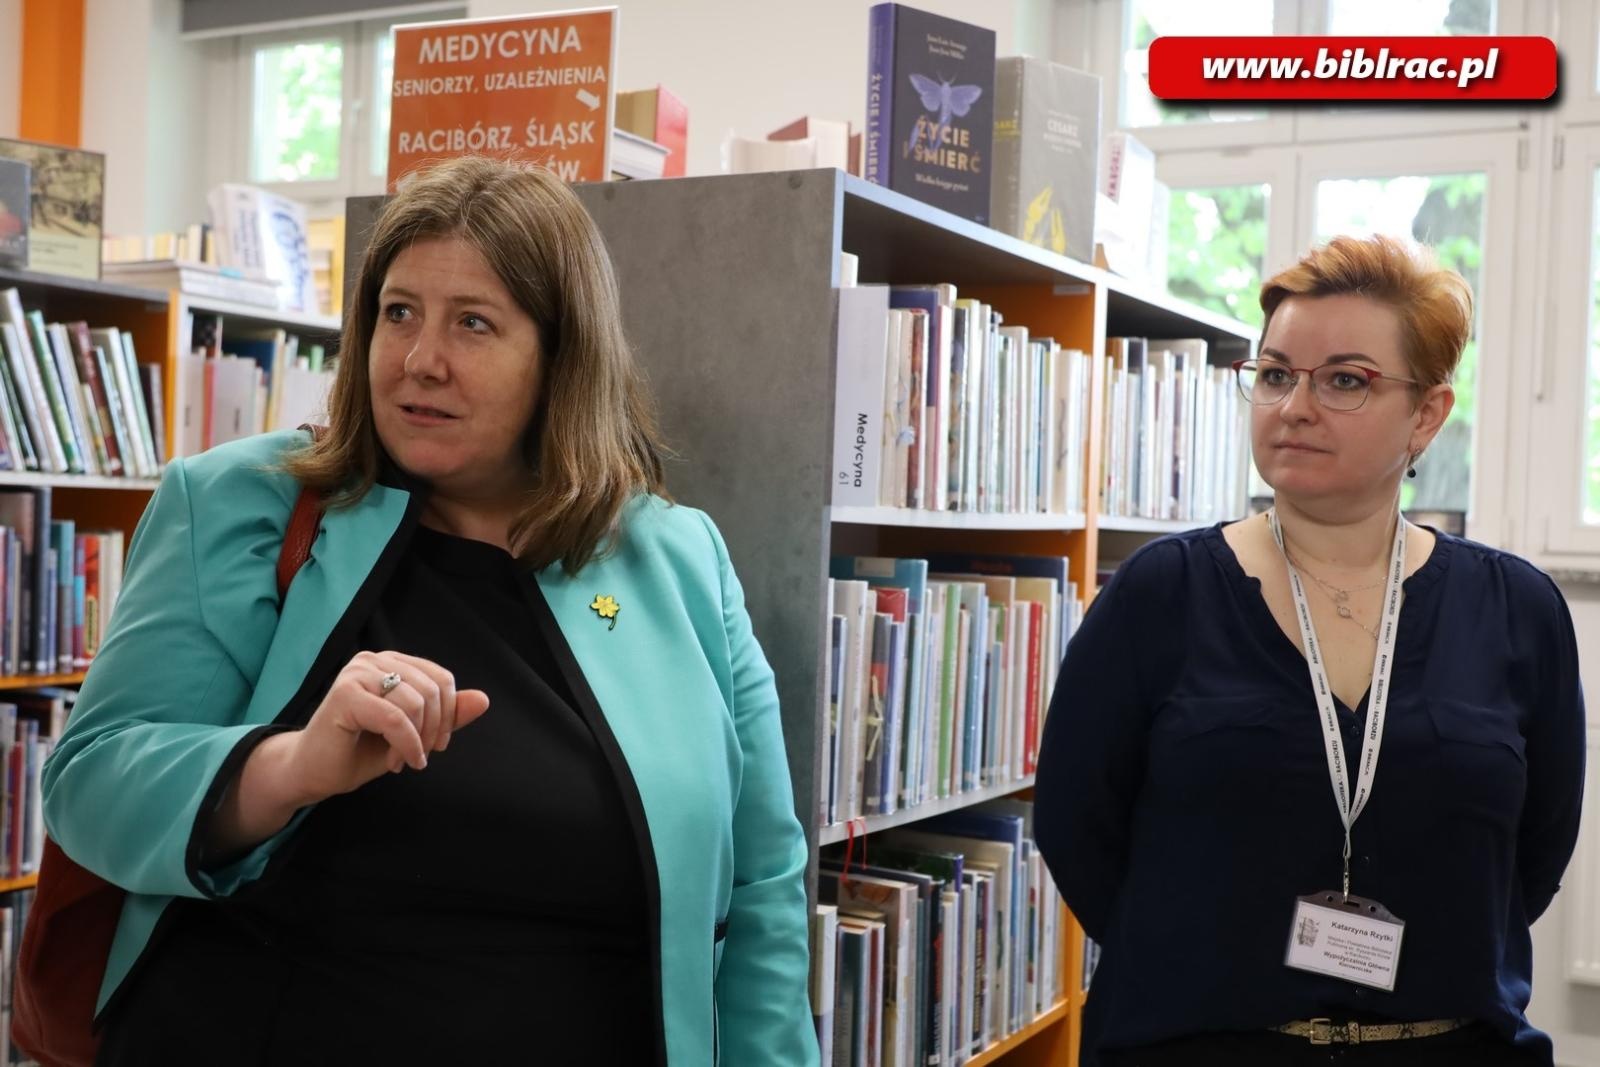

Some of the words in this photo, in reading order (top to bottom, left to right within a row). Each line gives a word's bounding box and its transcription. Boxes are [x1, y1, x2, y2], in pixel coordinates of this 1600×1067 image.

[418, 25, 582, 65] MEDYCYNA
[393, 75, 479, 97] SENIORZY,
[484, 65, 607, 92] UZALEŻNIENIA
[870, 73, 883, 119] ŻYCIE
[398, 120, 517, 154] RACIBÓRZ,
[525, 118, 595, 150] ŚLĄSK
[916, 114, 970, 148] ŻYCIE
[914, 139, 981, 173] ŚMIERĆ
[852, 412, 868, 488] Medycyna
[838, 471, 850, 485] 61
[1331, 921, 1369, 936] Katarzyna
